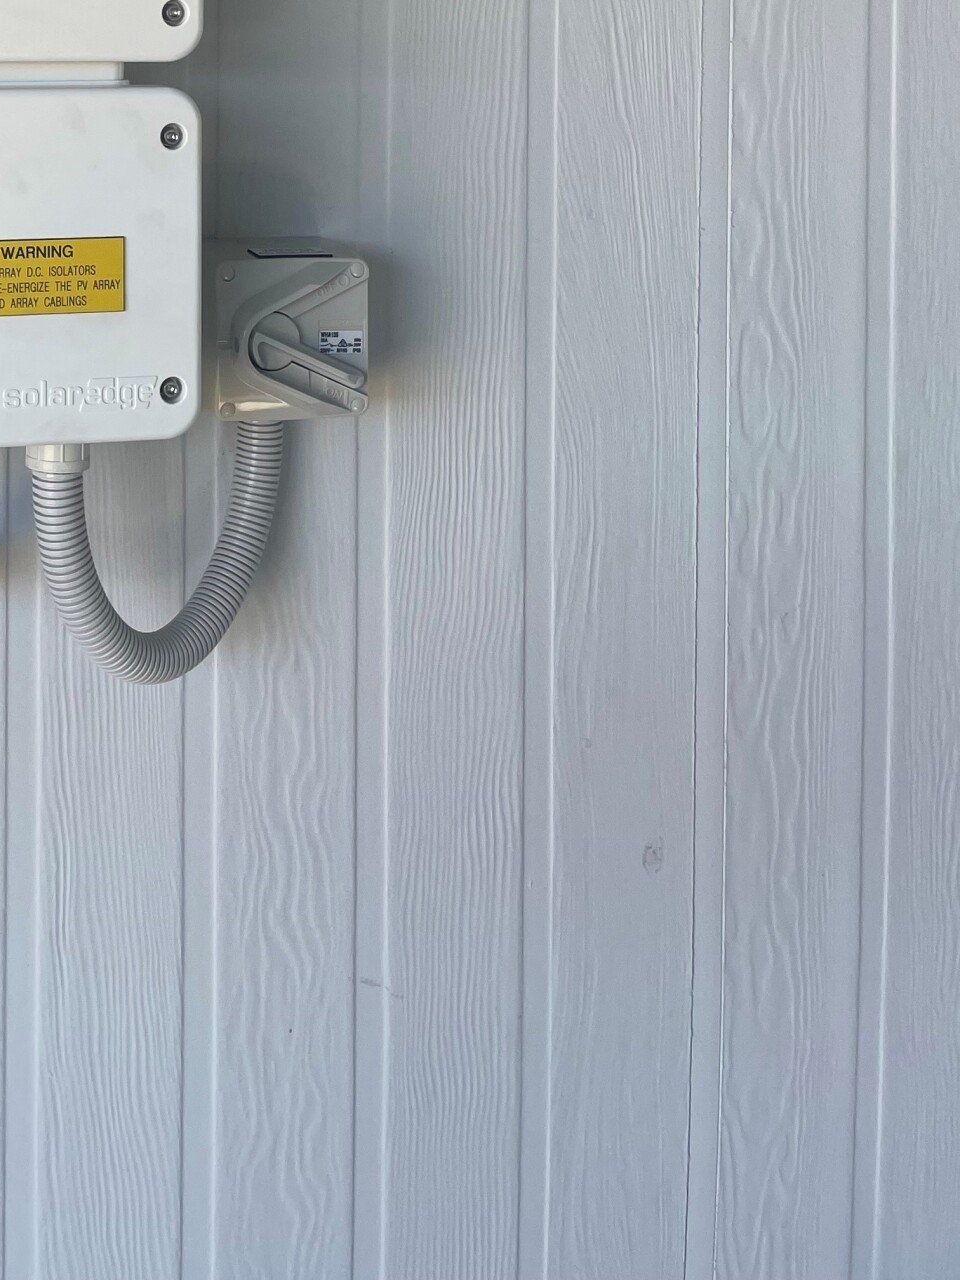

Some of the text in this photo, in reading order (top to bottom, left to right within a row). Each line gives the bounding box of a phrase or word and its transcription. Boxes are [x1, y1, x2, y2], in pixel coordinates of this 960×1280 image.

[1, 245, 73, 259] WARNING
[27, 267, 43, 276] D.C.
[49, 265, 96, 276] ISOLATORS
[55, 282, 71, 291] THE
[77, 281, 88, 291] PV
[93, 280, 120, 290] ARRAY
[10, 297, 38, 308] ARRAY
[44, 296, 87, 307] CABLINGS
